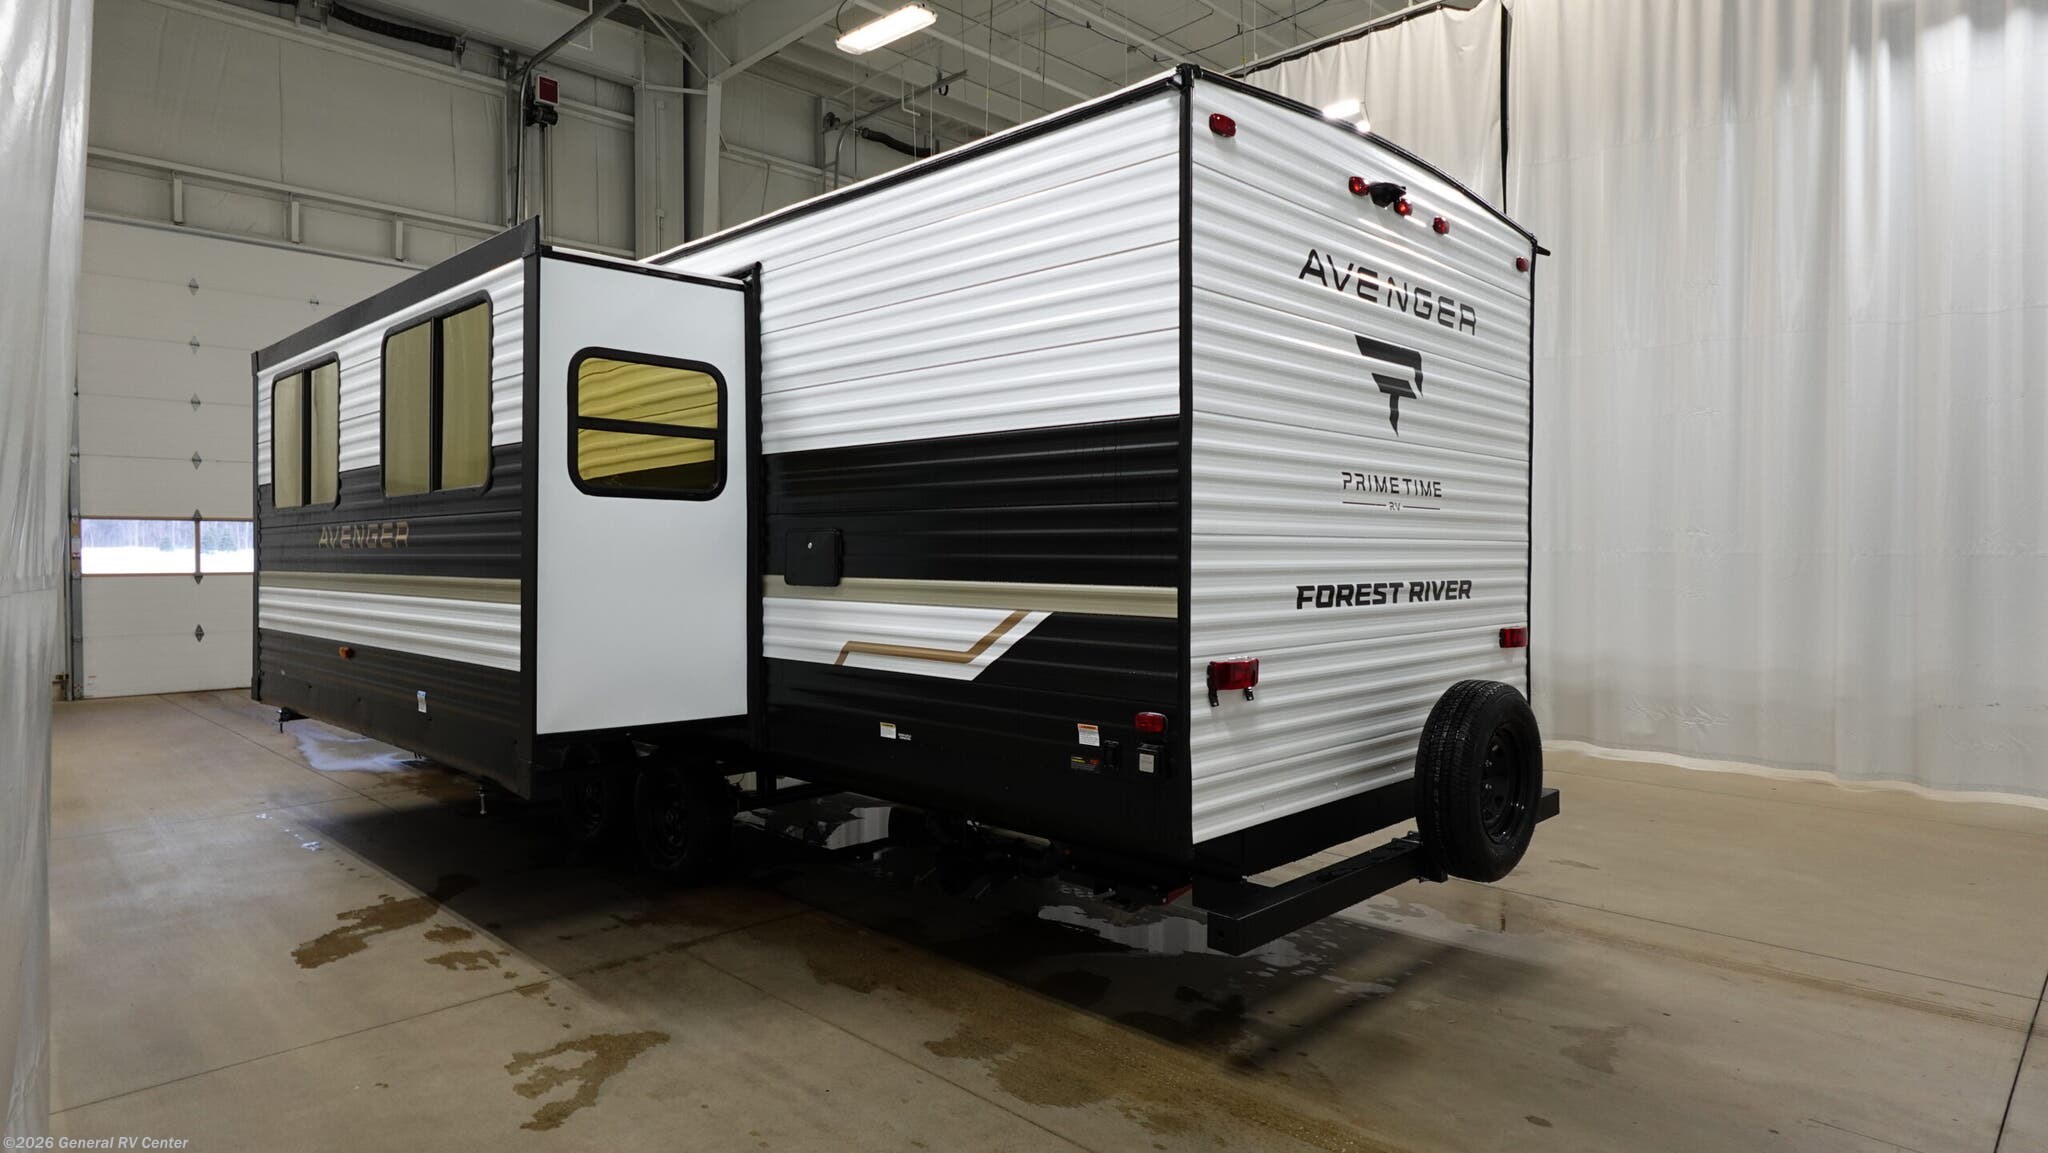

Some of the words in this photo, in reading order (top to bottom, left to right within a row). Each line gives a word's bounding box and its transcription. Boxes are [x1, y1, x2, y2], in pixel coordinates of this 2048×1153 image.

[1298, 248, 1477, 336] AVENGER
[1388, 501, 1401, 512] RV
[318, 520, 411, 549] AVENGER
[1296, 582, 1404, 610] FOREST
[1408, 580, 1473, 603] RIVER
